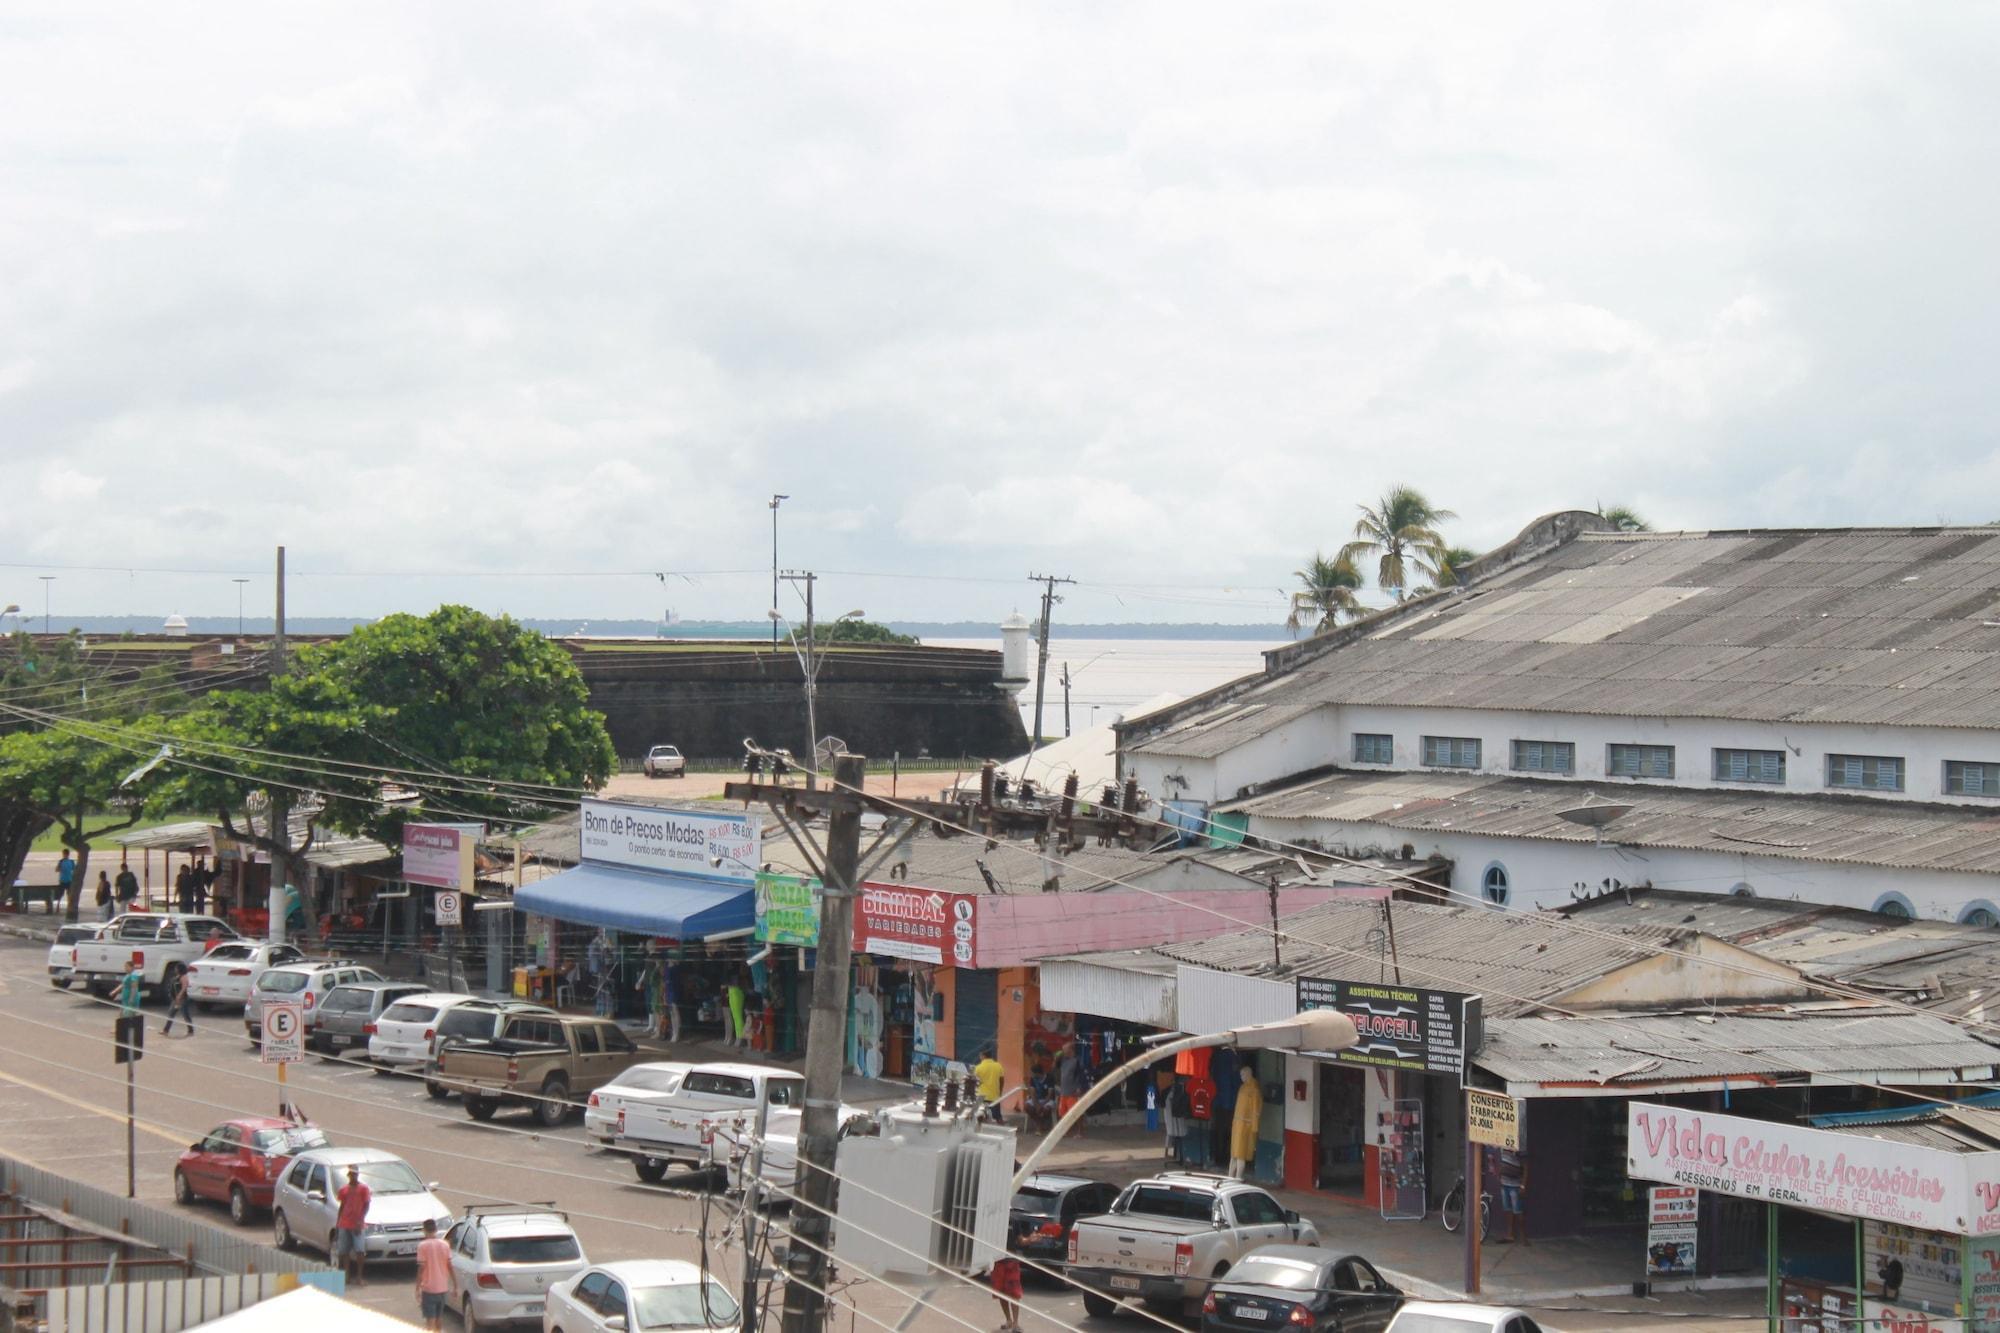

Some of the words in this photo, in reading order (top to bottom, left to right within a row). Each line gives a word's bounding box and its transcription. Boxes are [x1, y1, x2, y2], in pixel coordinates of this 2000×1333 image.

[585, 811, 608, 832] Bom
[610, 815, 623, 835] de
[626, 816, 664, 844] Preços
[666, 821, 704, 846] Modas
[732, 823, 740, 836] R$
[628, 842, 634, 852] O
[634, 844, 650, 856] ponto
[677, 850, 704, 861] economia
[709, 842, 717, 856] R$
[444, 897, 452, 909] E
[863, 889, 946, 923] BIRIMBAL
[867, 917, 942, 938] VARIEDADES
[1349, 986, 1389, 1000] ASSISTÊNCIA
[1391, 988, 1418, 1003] TÉCNICA
[1429, 1003, 1445, 1012] TOUCH
[278, 1014, 288, 1032] E
[1428, 1038, 1455, 1047] CELULARES
[1439, 1031, 1453, 1039] DRIVE
[1471, 1094, 1514, 1112] CONSERTOS
[1470, 1105, 1475, 1115] E
[1476, 1106, 1515, 1123] FABRICAÇÃO
[1470, 1116, 1477, 1126] DE
[1636, 1113, 1728, 1167] Vida
[1732, 1136, 1812, 1179] Celular
[1815, 1159, 1827, 1180] &
[1746, 1183, 1760, 1195] EM
[1787, 1176, 1830, 1196] TABLET
[1836, 1186, 1844, 1198] E
[1815, 1196, 1848, 1212] CAPAS
[1852, 1201, 1859, 1213] E
[1881, 1308, 1944, 1333] Vid
